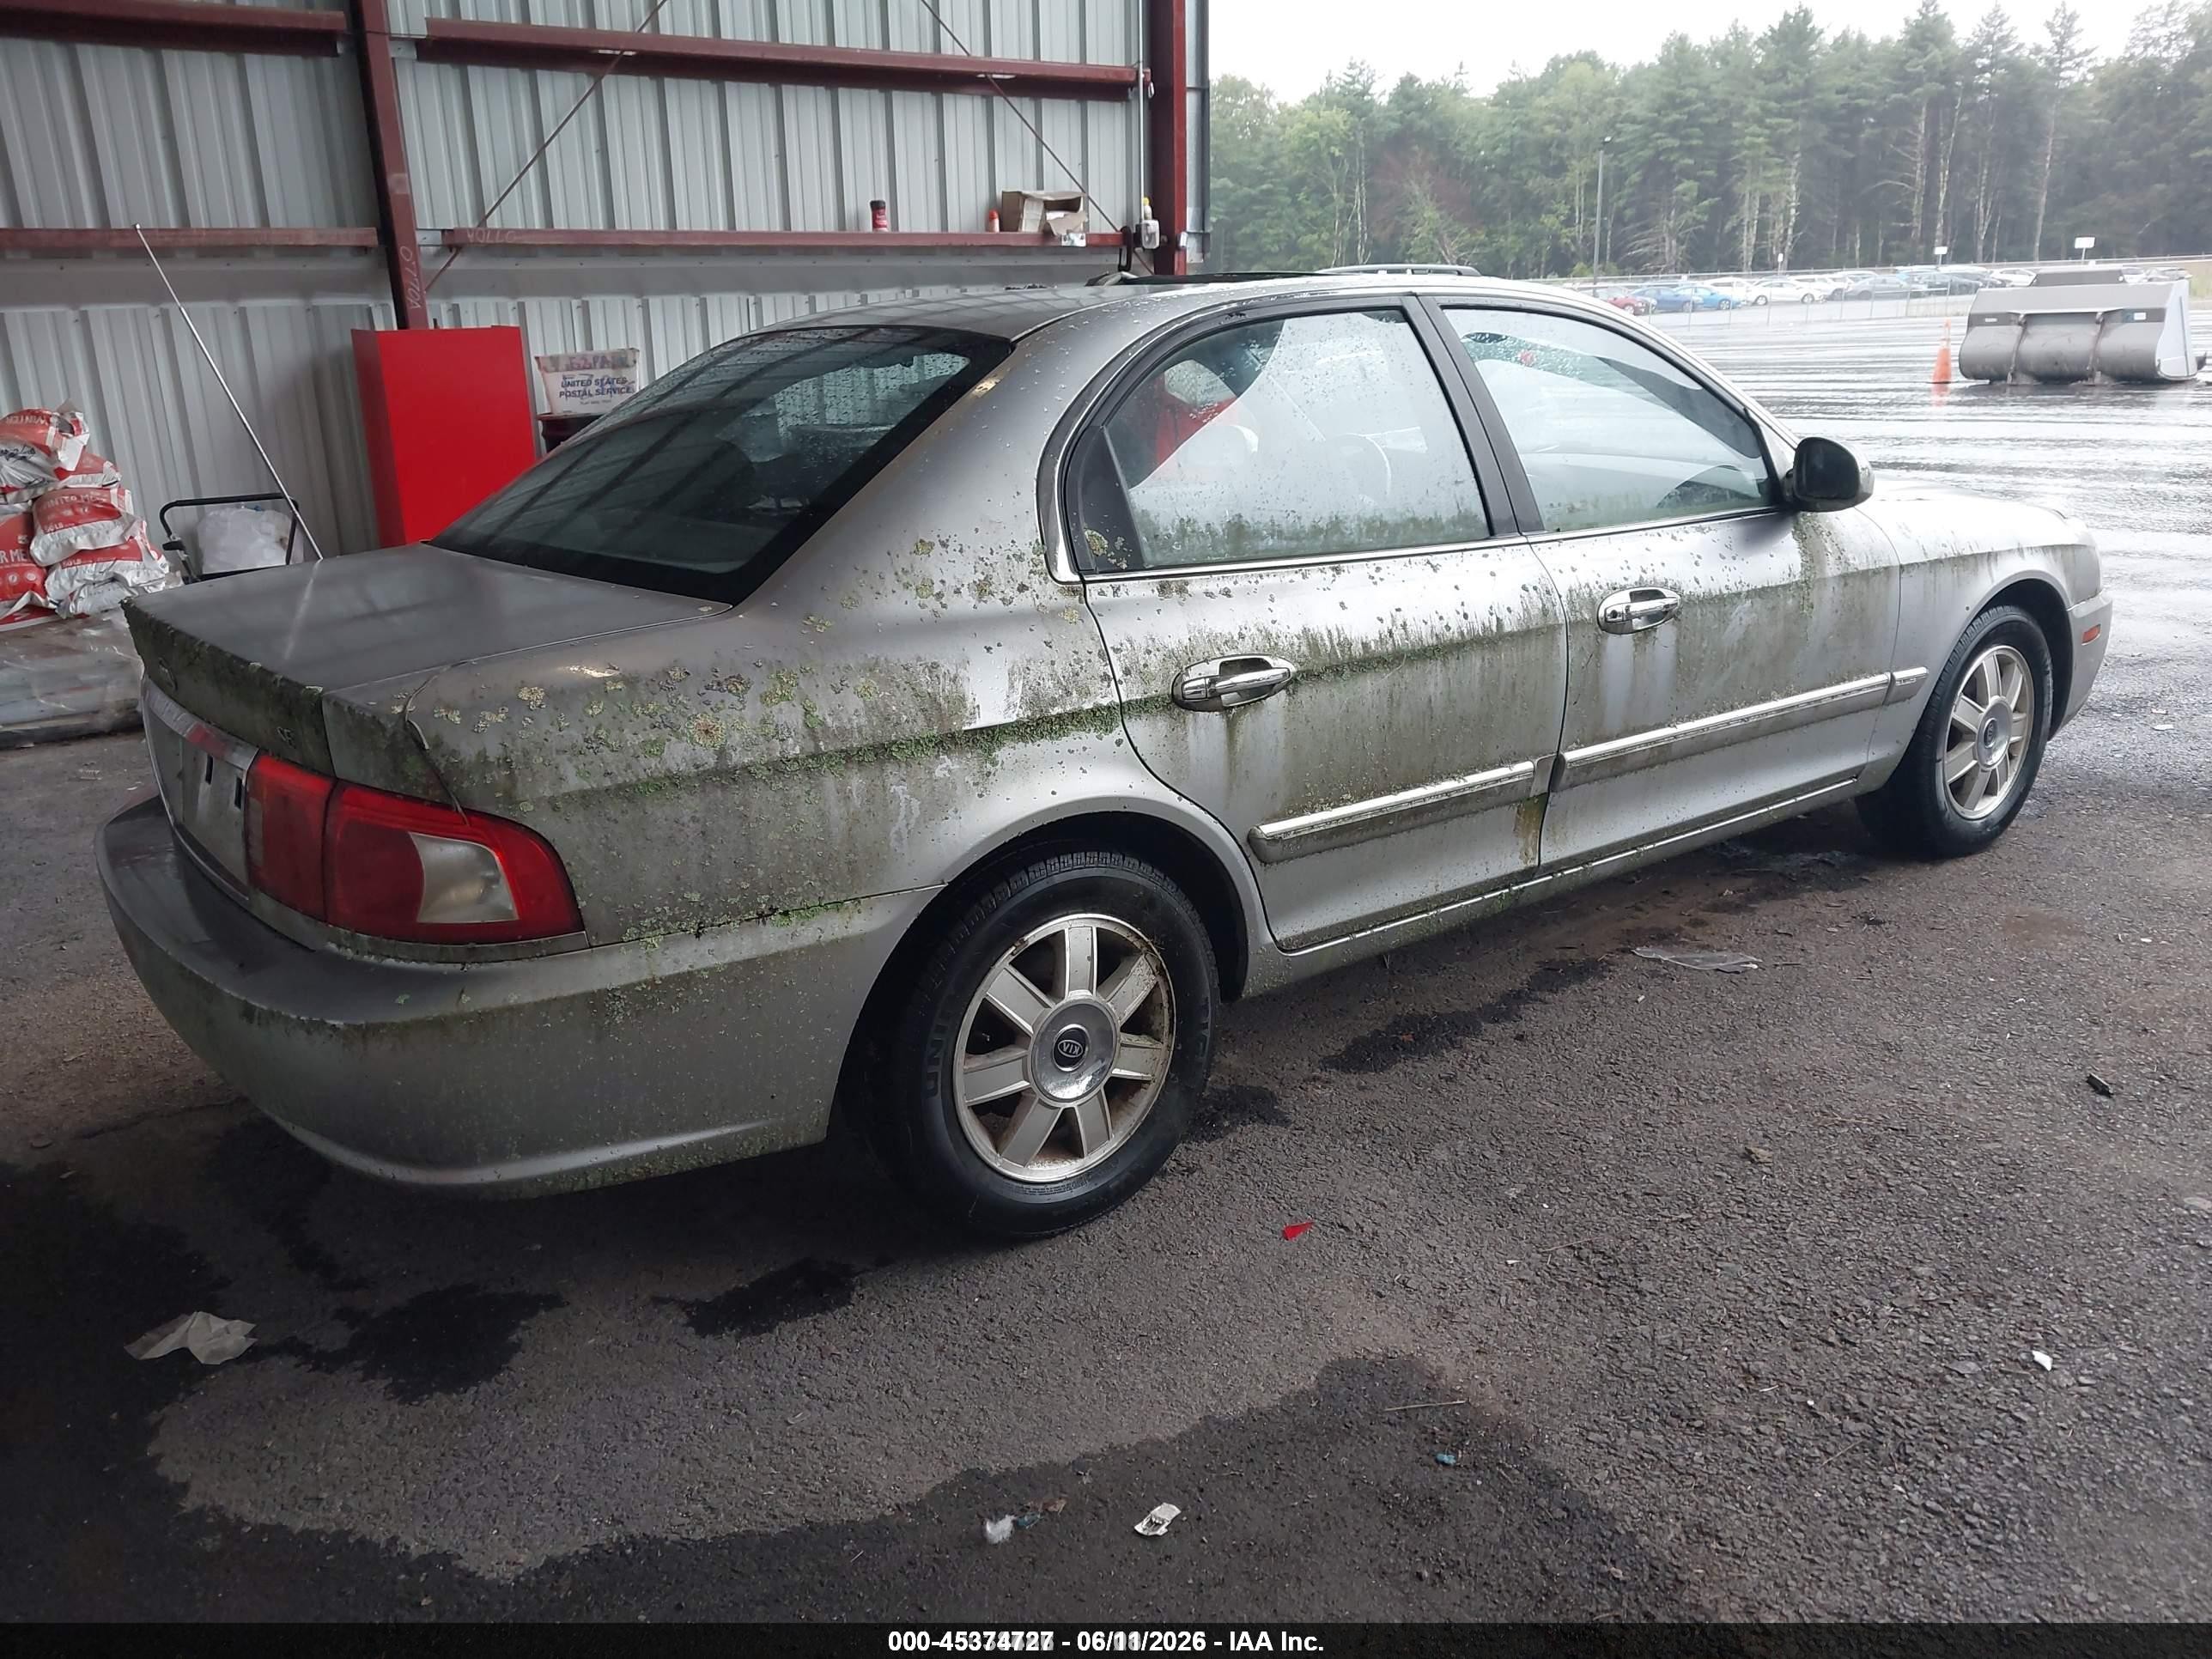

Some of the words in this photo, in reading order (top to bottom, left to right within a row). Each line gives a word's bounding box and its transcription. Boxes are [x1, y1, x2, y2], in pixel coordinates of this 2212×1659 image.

[561, 379, 592, 388] UNITED
[594, 377, 628, 386] STATES
[1061, 1042, 1081, 1056] KIA
